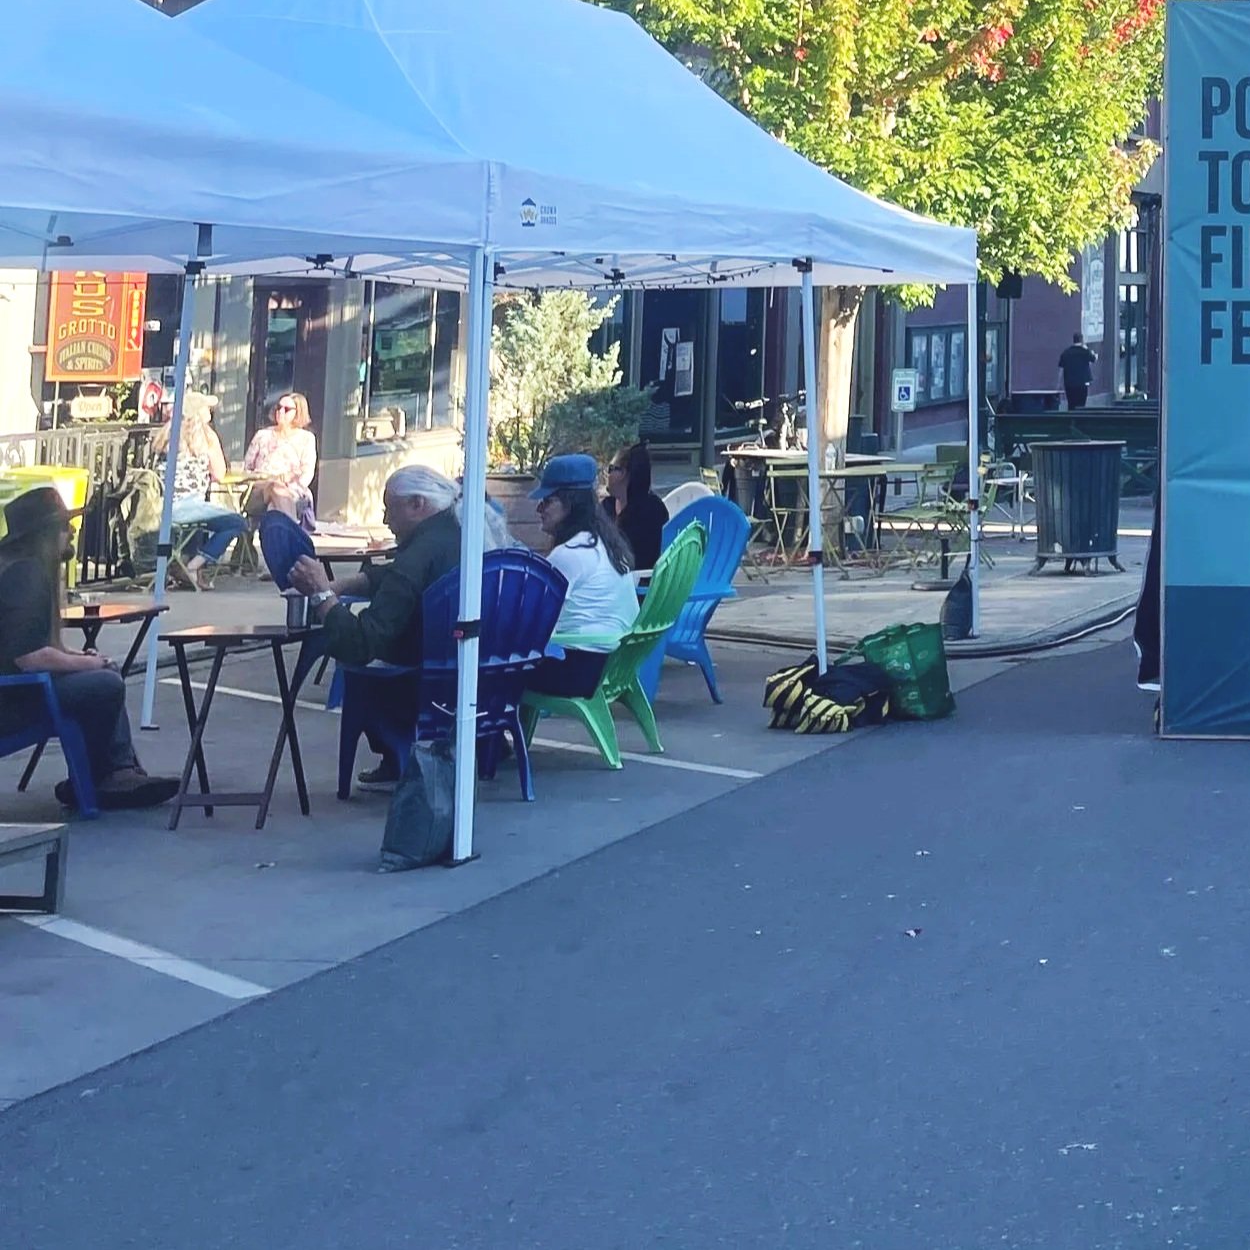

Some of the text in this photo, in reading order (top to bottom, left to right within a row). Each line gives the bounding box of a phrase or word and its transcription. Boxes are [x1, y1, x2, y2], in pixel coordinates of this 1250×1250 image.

[58, 318, 116, 340] GROTTO
[66, 356, 104, 371] & SPIRITS
[79, 400, 102, 414] Open
